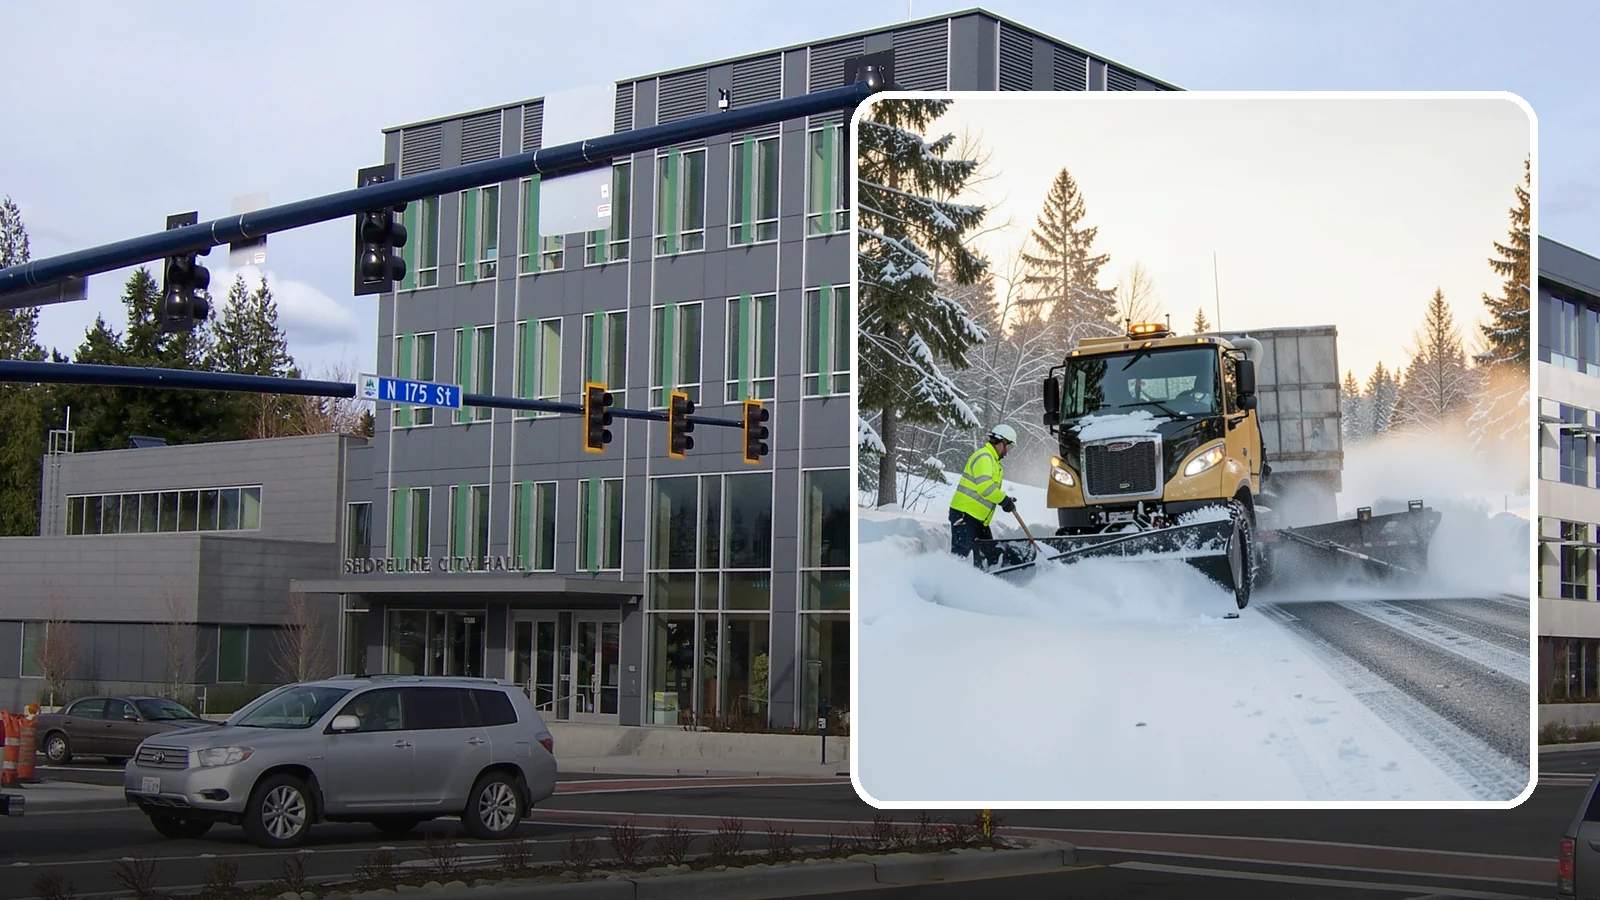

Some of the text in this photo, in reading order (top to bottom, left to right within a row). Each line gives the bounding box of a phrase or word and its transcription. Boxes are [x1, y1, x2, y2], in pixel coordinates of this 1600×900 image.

[387, 380, 452, 406] N 175 St
[343, 555, 525, 574] SHORELINE CITY HALL
